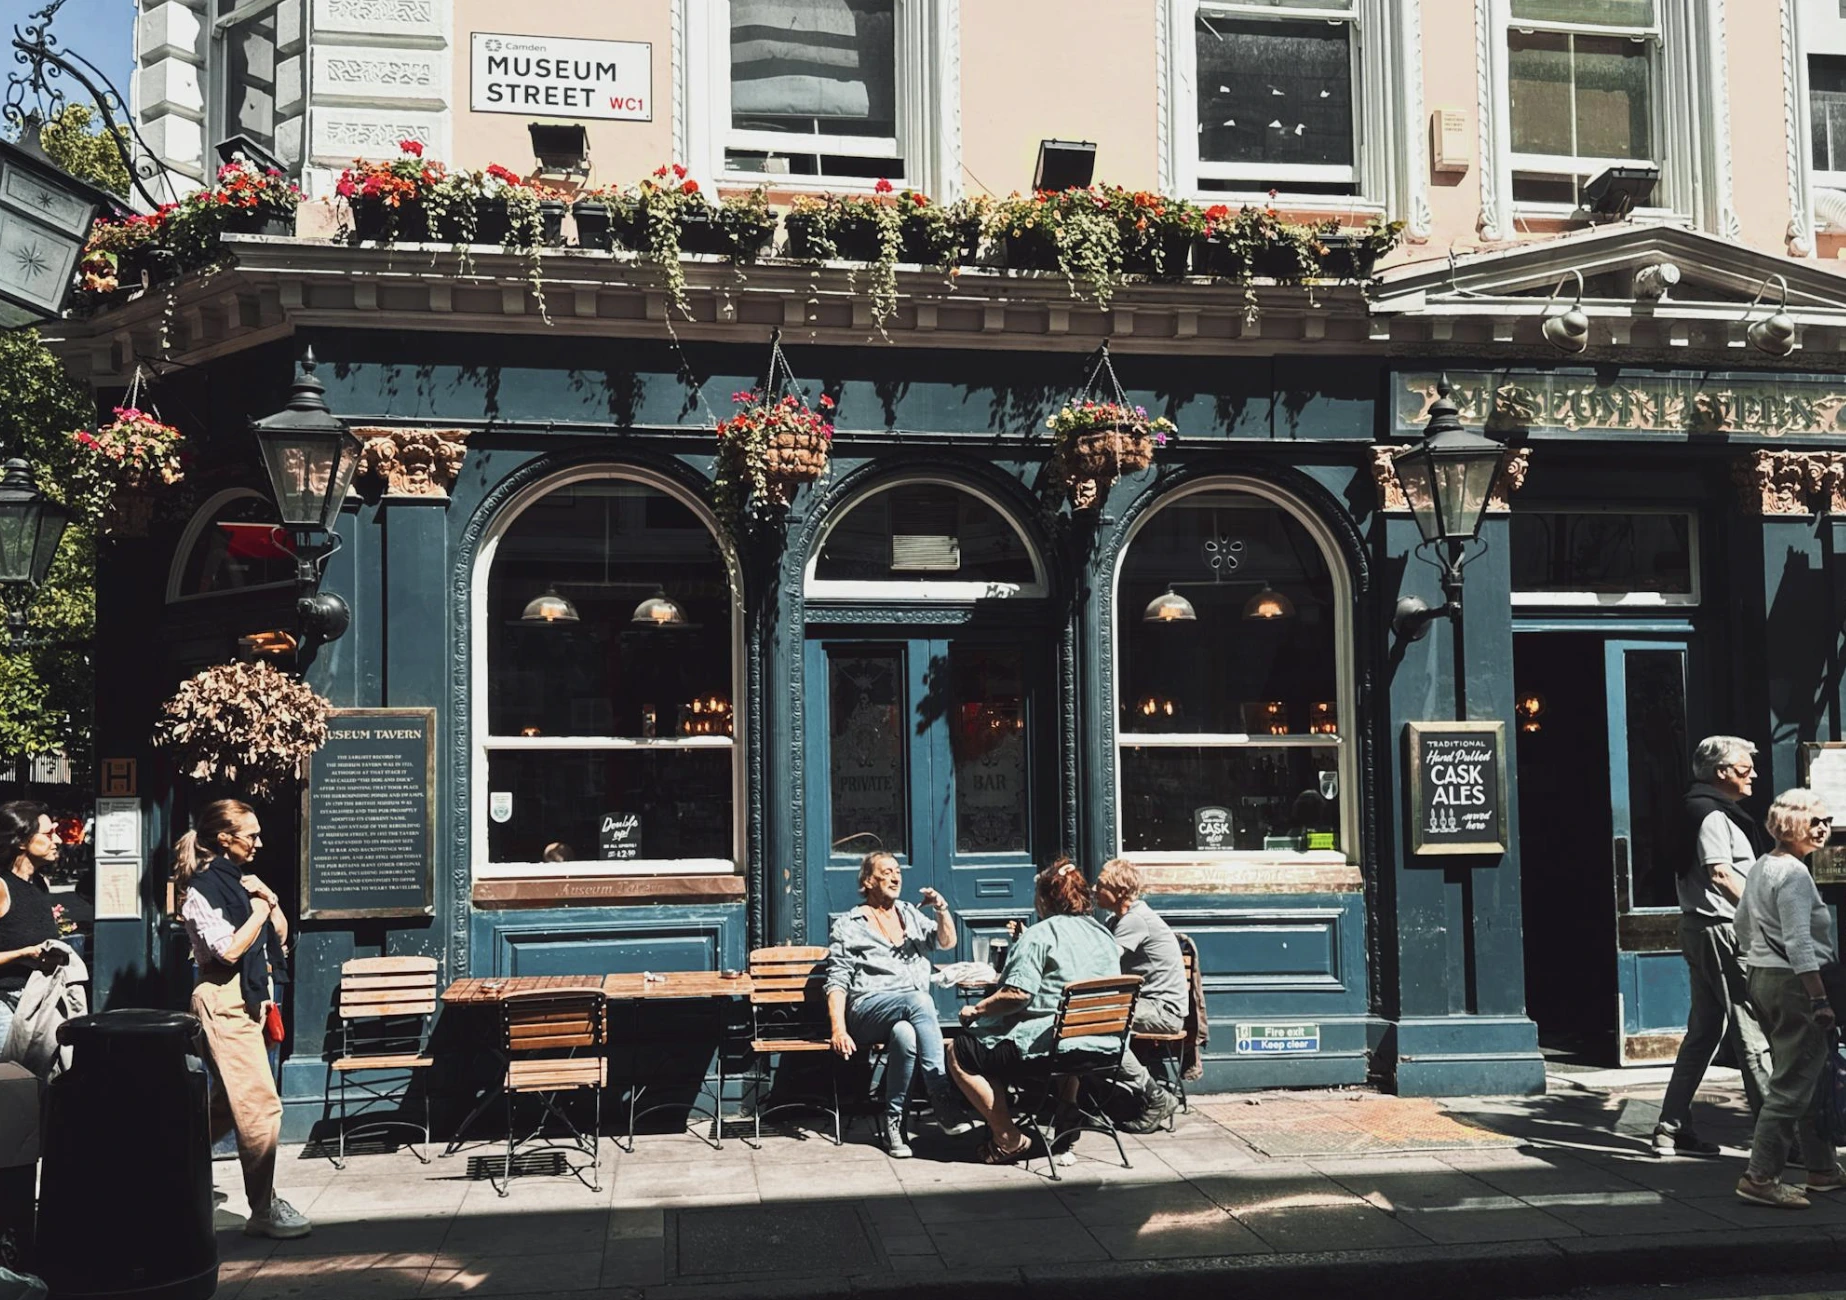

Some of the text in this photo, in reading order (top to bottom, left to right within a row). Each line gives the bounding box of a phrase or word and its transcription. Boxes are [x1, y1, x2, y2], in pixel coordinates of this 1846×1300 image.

[505, 42, 547, 52] Camden
[487, 55, 617, 82] MUSEUM
[486, 82, 643, 111] STREET WC1
[325, 729, 422, 740] USEUM TAVERN
[1426, 740, 1486, 748] TRADITIONAL
[1425, 749, 1492, 765] Hand Pulled
[1430, 764, 1484, 785] CASK
[840, 774, 1007, 792] PRIVATE BAR
[1432, 785, 1486, 806] ALES
[601, 815, 639, 832] Double
[1198, 822, 1230, 835] CASK
[1465, 820, 1486, 830] here
[1264, 1027, 1305, 1037] Fire exit
[1261, 1040, 1309, 1051] Keep clear
